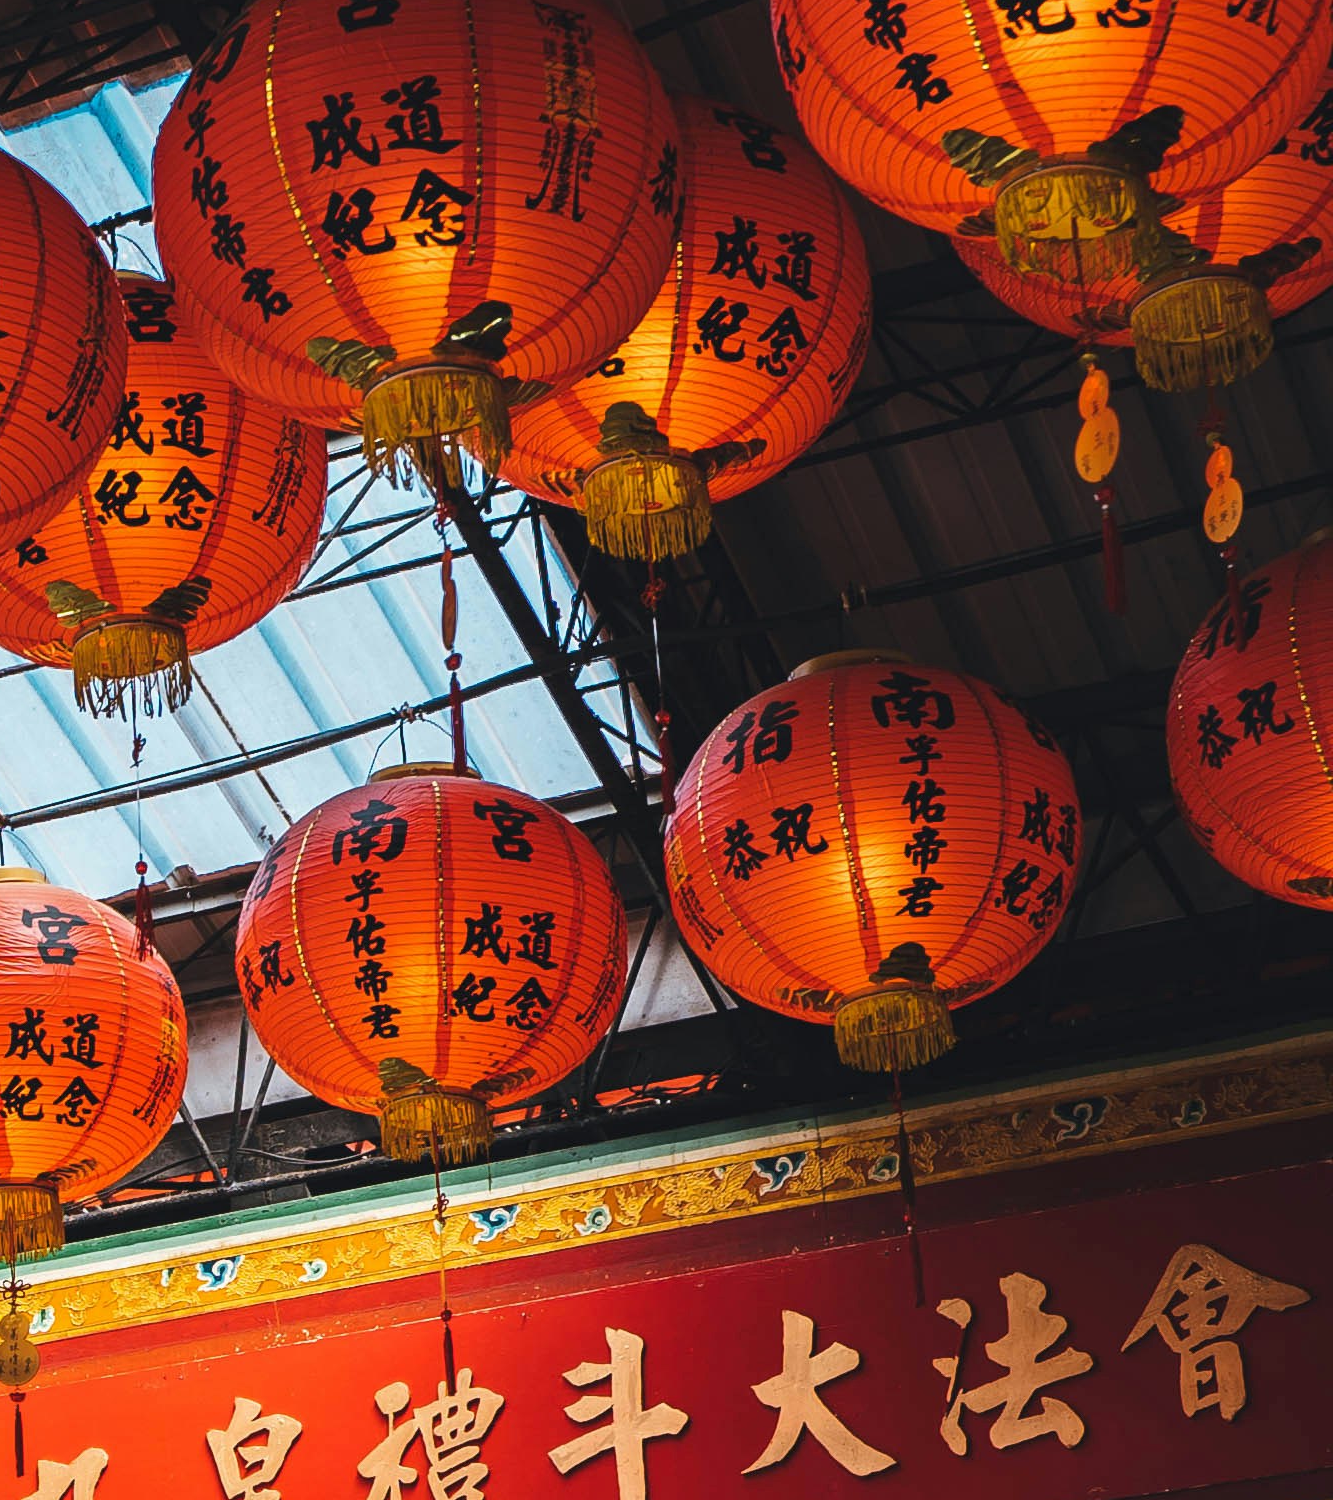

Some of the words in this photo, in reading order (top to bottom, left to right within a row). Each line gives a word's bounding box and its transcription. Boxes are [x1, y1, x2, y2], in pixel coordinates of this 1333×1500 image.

[306, 75, 463, 174] 成道
[322, 169, 474, 259] 紀念
[95, 464, 212, 532] 紀念
[723, 801, 828, 880] 恭祝
[895, 735, 948, 919] 孚佑帝君
[344, 869, 401, 1039] 孚佑帝君
[460, 902, 559, 970] 成道
[451, 972, 551, 1030] 紀念
[5, 1007, 105, 1069] 成道
[0, 1075, 100, 1127] 紀念
